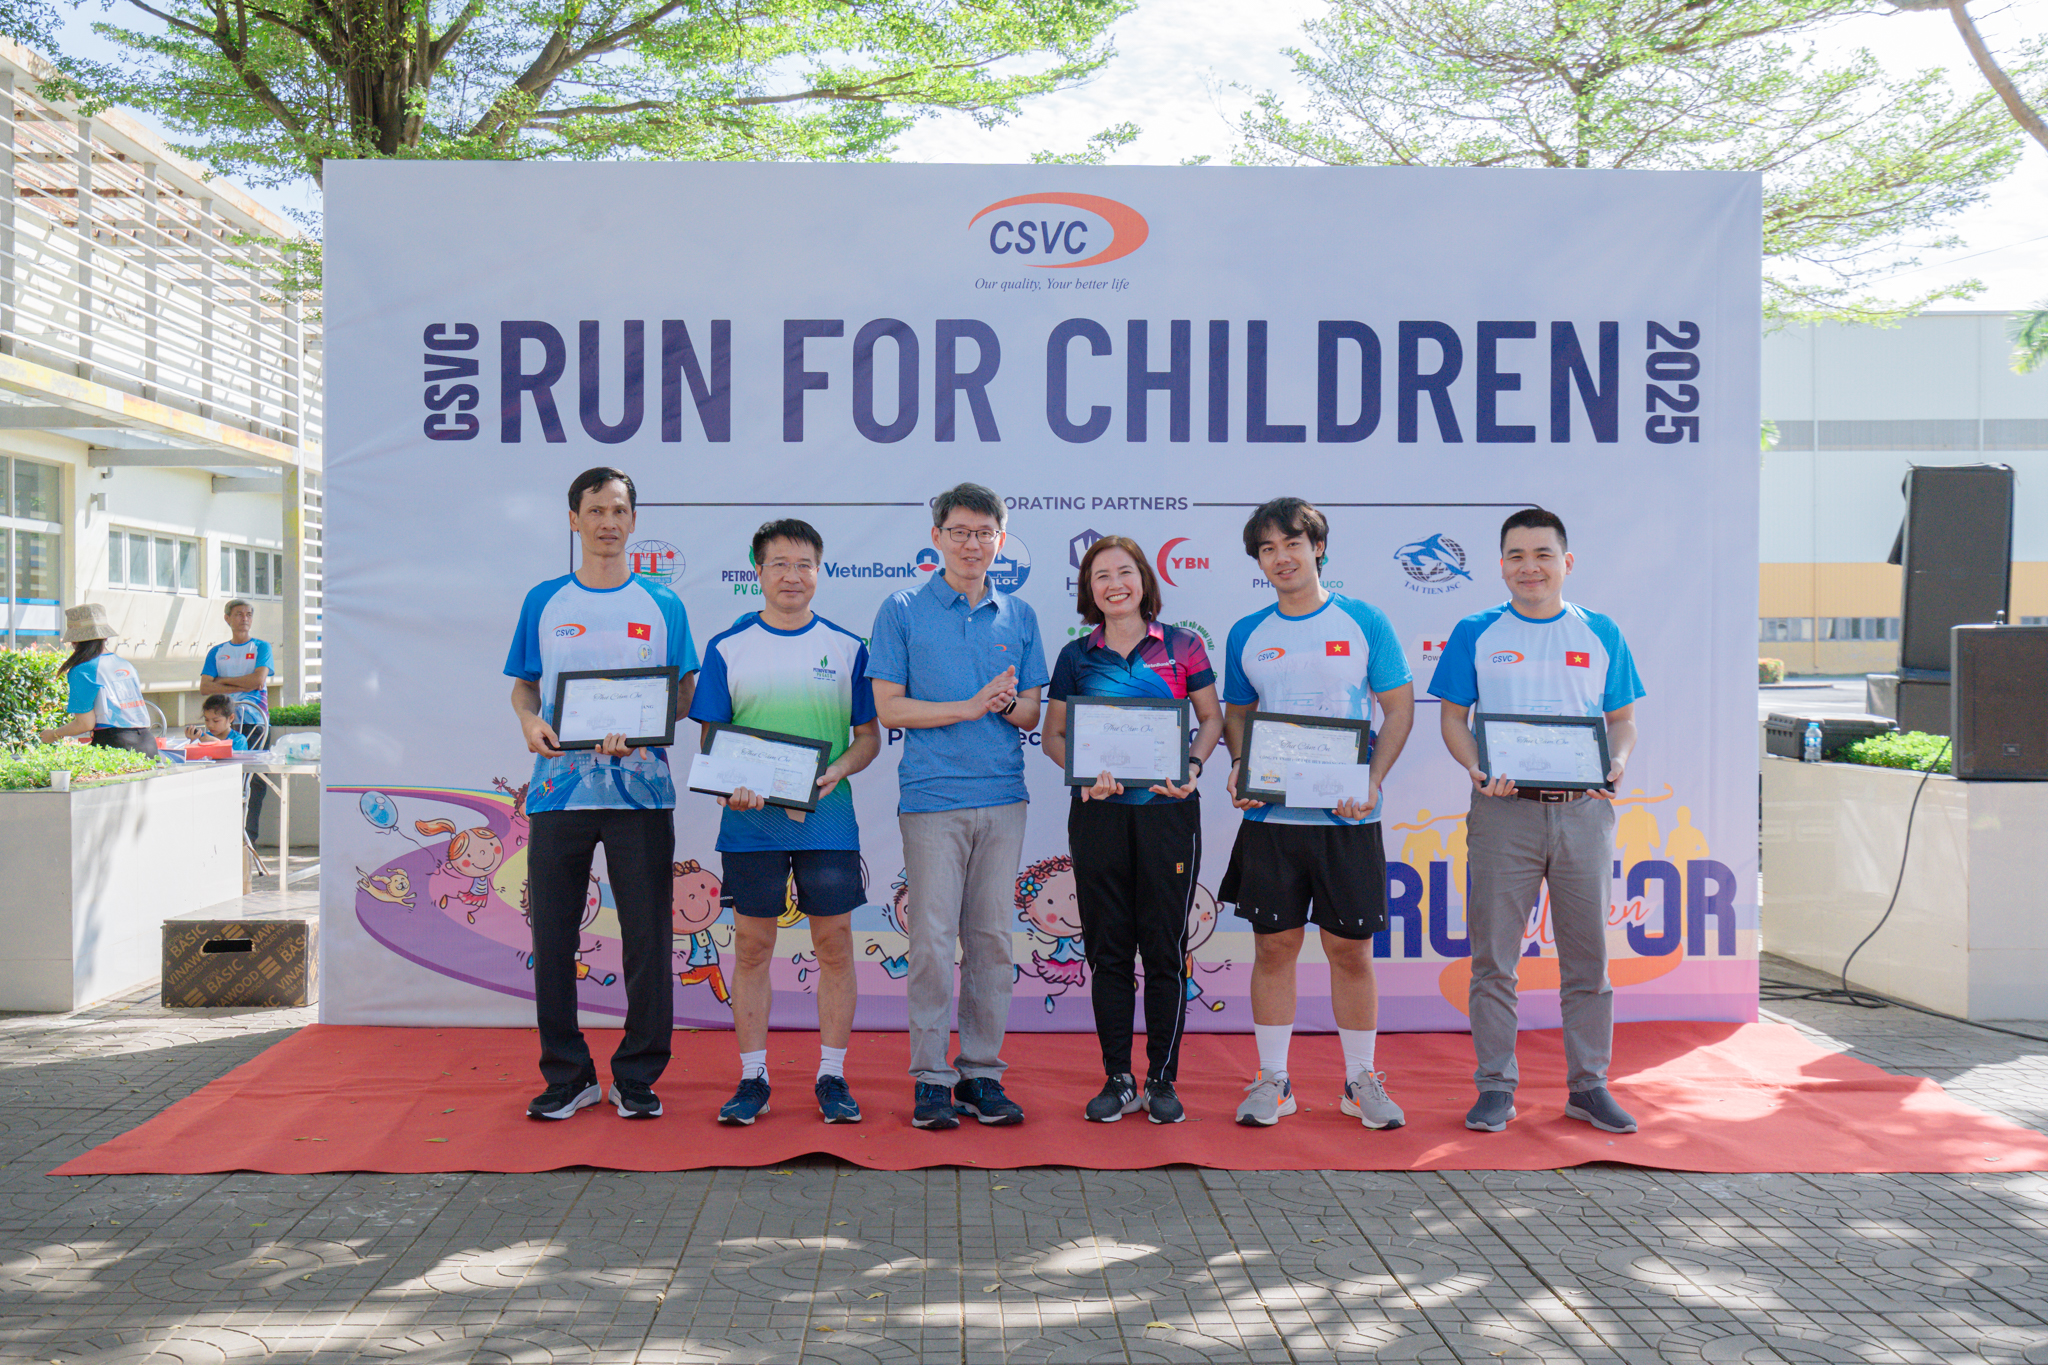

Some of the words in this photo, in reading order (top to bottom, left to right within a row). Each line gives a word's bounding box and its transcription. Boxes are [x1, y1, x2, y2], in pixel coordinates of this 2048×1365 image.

[989, 220, 1089, 255] CSVC
[974, 277, 998, 290] Our
[1000, 277, 1042, 292] quality,
[1047, 277, 1073, 290] Your
[1075, 277, 1109, 290] better
[1111, 277, 1130, 292] life
[423, 322, 480, 441] CSVC
[500, 319, 731, 444] RUN
[783, 317, 1001, 444] FOR
[1045, 317, 1619, 443] CHILDREN
[1645, 320, 1701, 445] 2025
[1091, 496, 1189, 511] PARTNERS
[824, 562, 918, 578] VietinBank
[1170, 557, 1210, 570] YBN
[721, 570, 759, 582] PETROV
[991, 578, 1019, 586] LOC
[734, 583, 748, 596] PV
[1404, 580, 1420, 592] TAI
[1422, 586, 1444, 595] TIEN
[1445, 581, 1462, 593] JSC
[555, 628, 576, 637] CSVC
[1257, 651, 1276, 662] CSVC
[1422, 654, 1440, 662] Pow
[1492, 655, 1513, 664] CSVC
[1613, 860, 1738, 957] OR
[170, 924, 208, 958] BASIC
[280, 934, 306, 963] BAS
[206, 958, 244, 994] BASIC
